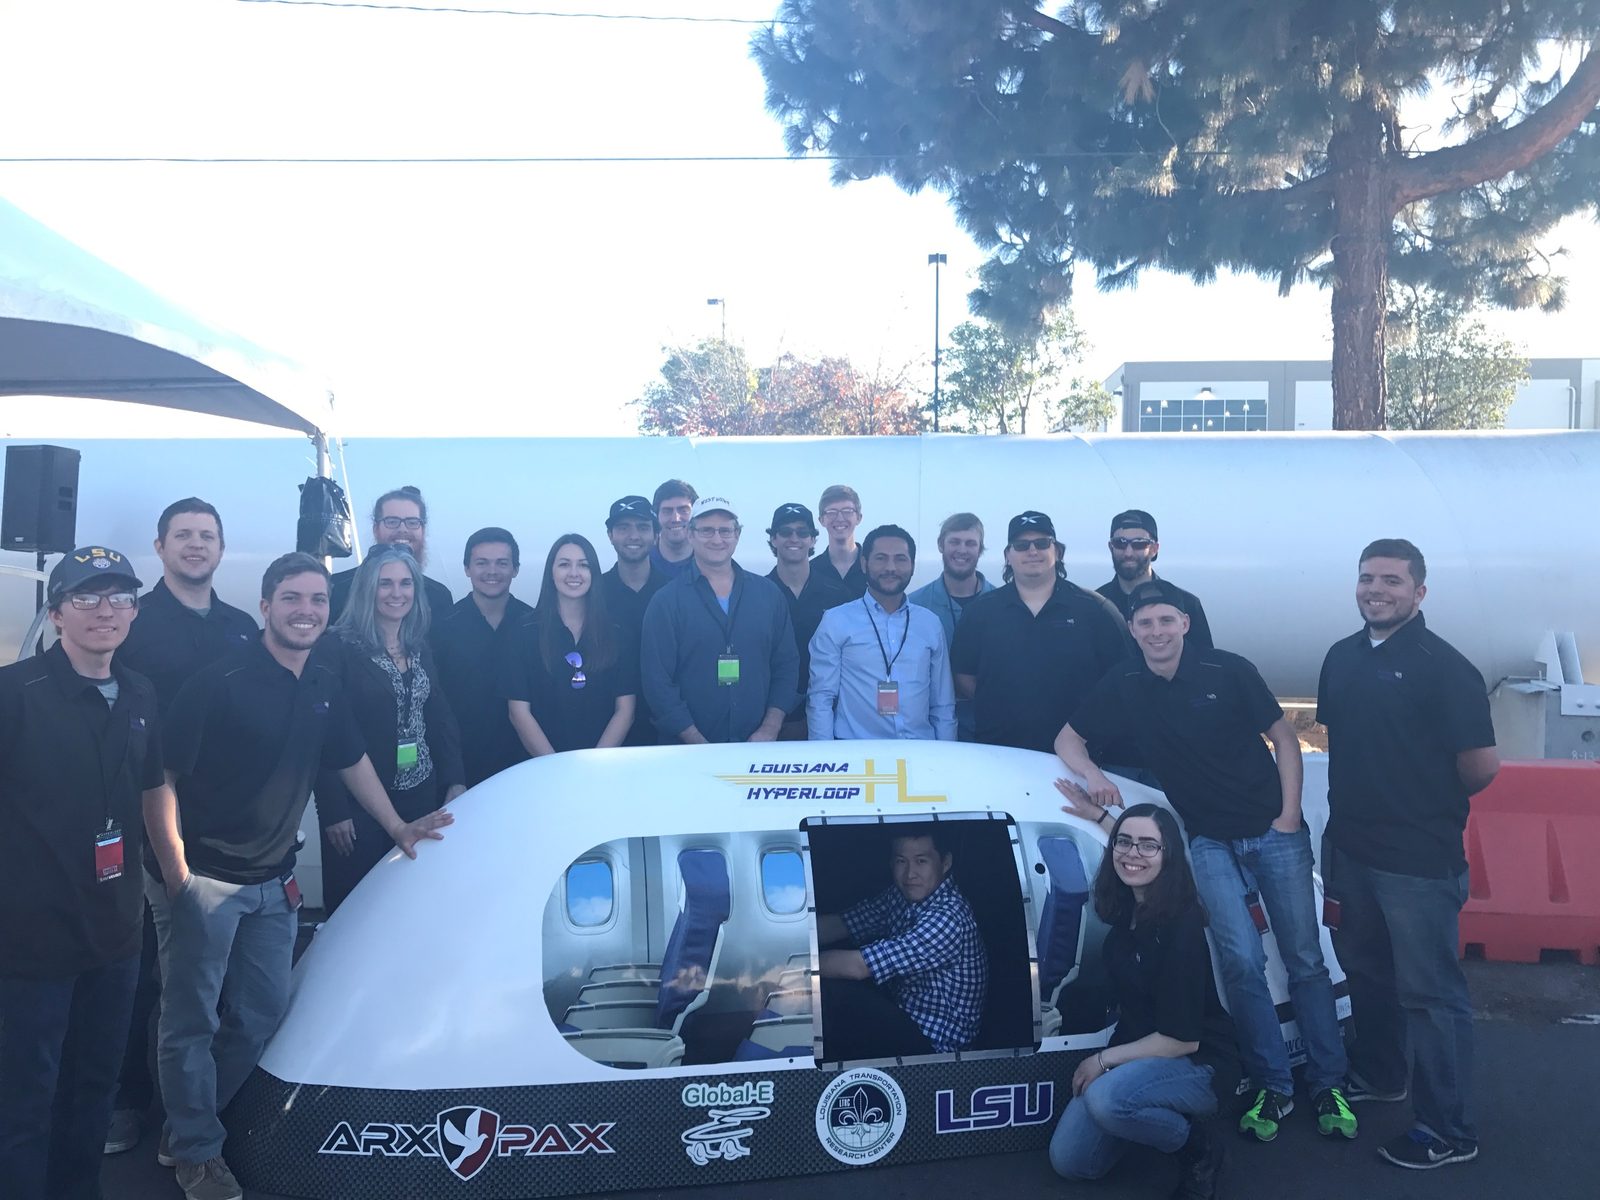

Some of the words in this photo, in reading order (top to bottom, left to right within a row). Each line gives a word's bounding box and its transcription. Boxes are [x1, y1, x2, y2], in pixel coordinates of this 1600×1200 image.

[74, 548, 121, 563] LSU
[749, 763, 849, 774] LOUISIANA
[747, 787, 860, 800] HYPERLOOP
[683, 1082, 774, 1107] Global-E
[820, 1079, 846, 1120] LOUISIANA
[849, 1073, 902, 1116] TRANSPORTATION
[936, 1081, 1054, 1134] LSU
[318, 1121, 440, 1157] ARX
[498, 1122, 616, 1157] PAX
[826, 1136, 866, 1160] RESEARCH
[867, 1131, 896, 1158] CENTER
